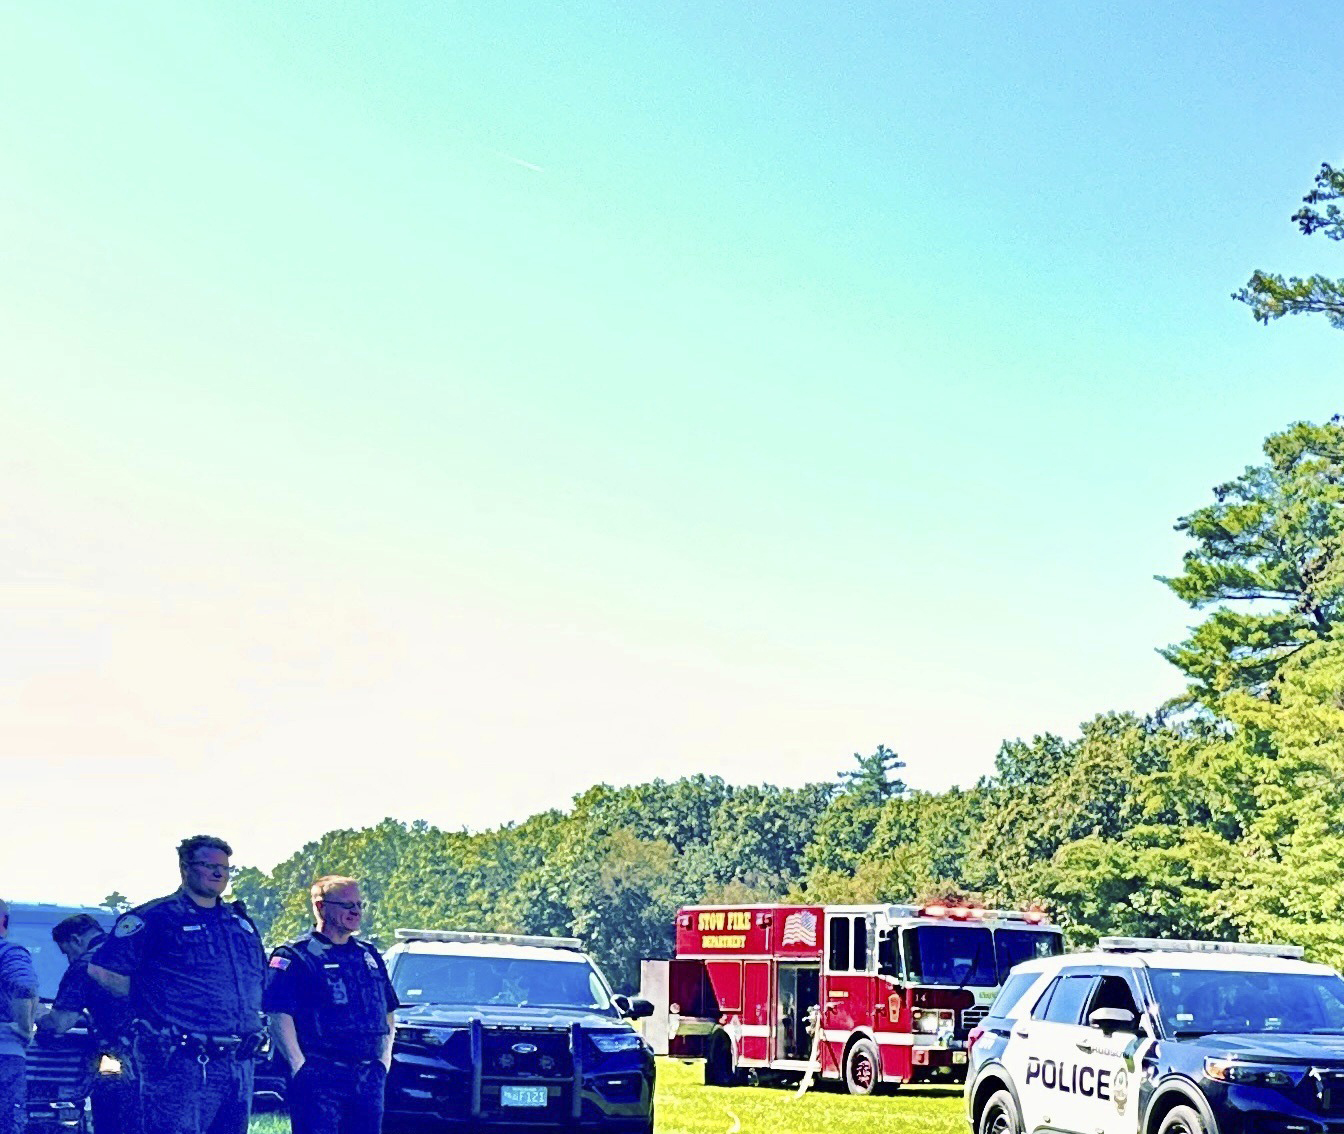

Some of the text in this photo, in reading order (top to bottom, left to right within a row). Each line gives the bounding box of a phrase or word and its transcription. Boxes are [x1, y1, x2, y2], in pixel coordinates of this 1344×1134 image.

[698, 911, 751, 931] STOW FIRE
[915, 994, 927, 1002] 14
[1026, 1056, 1112, 1101] POLICE
